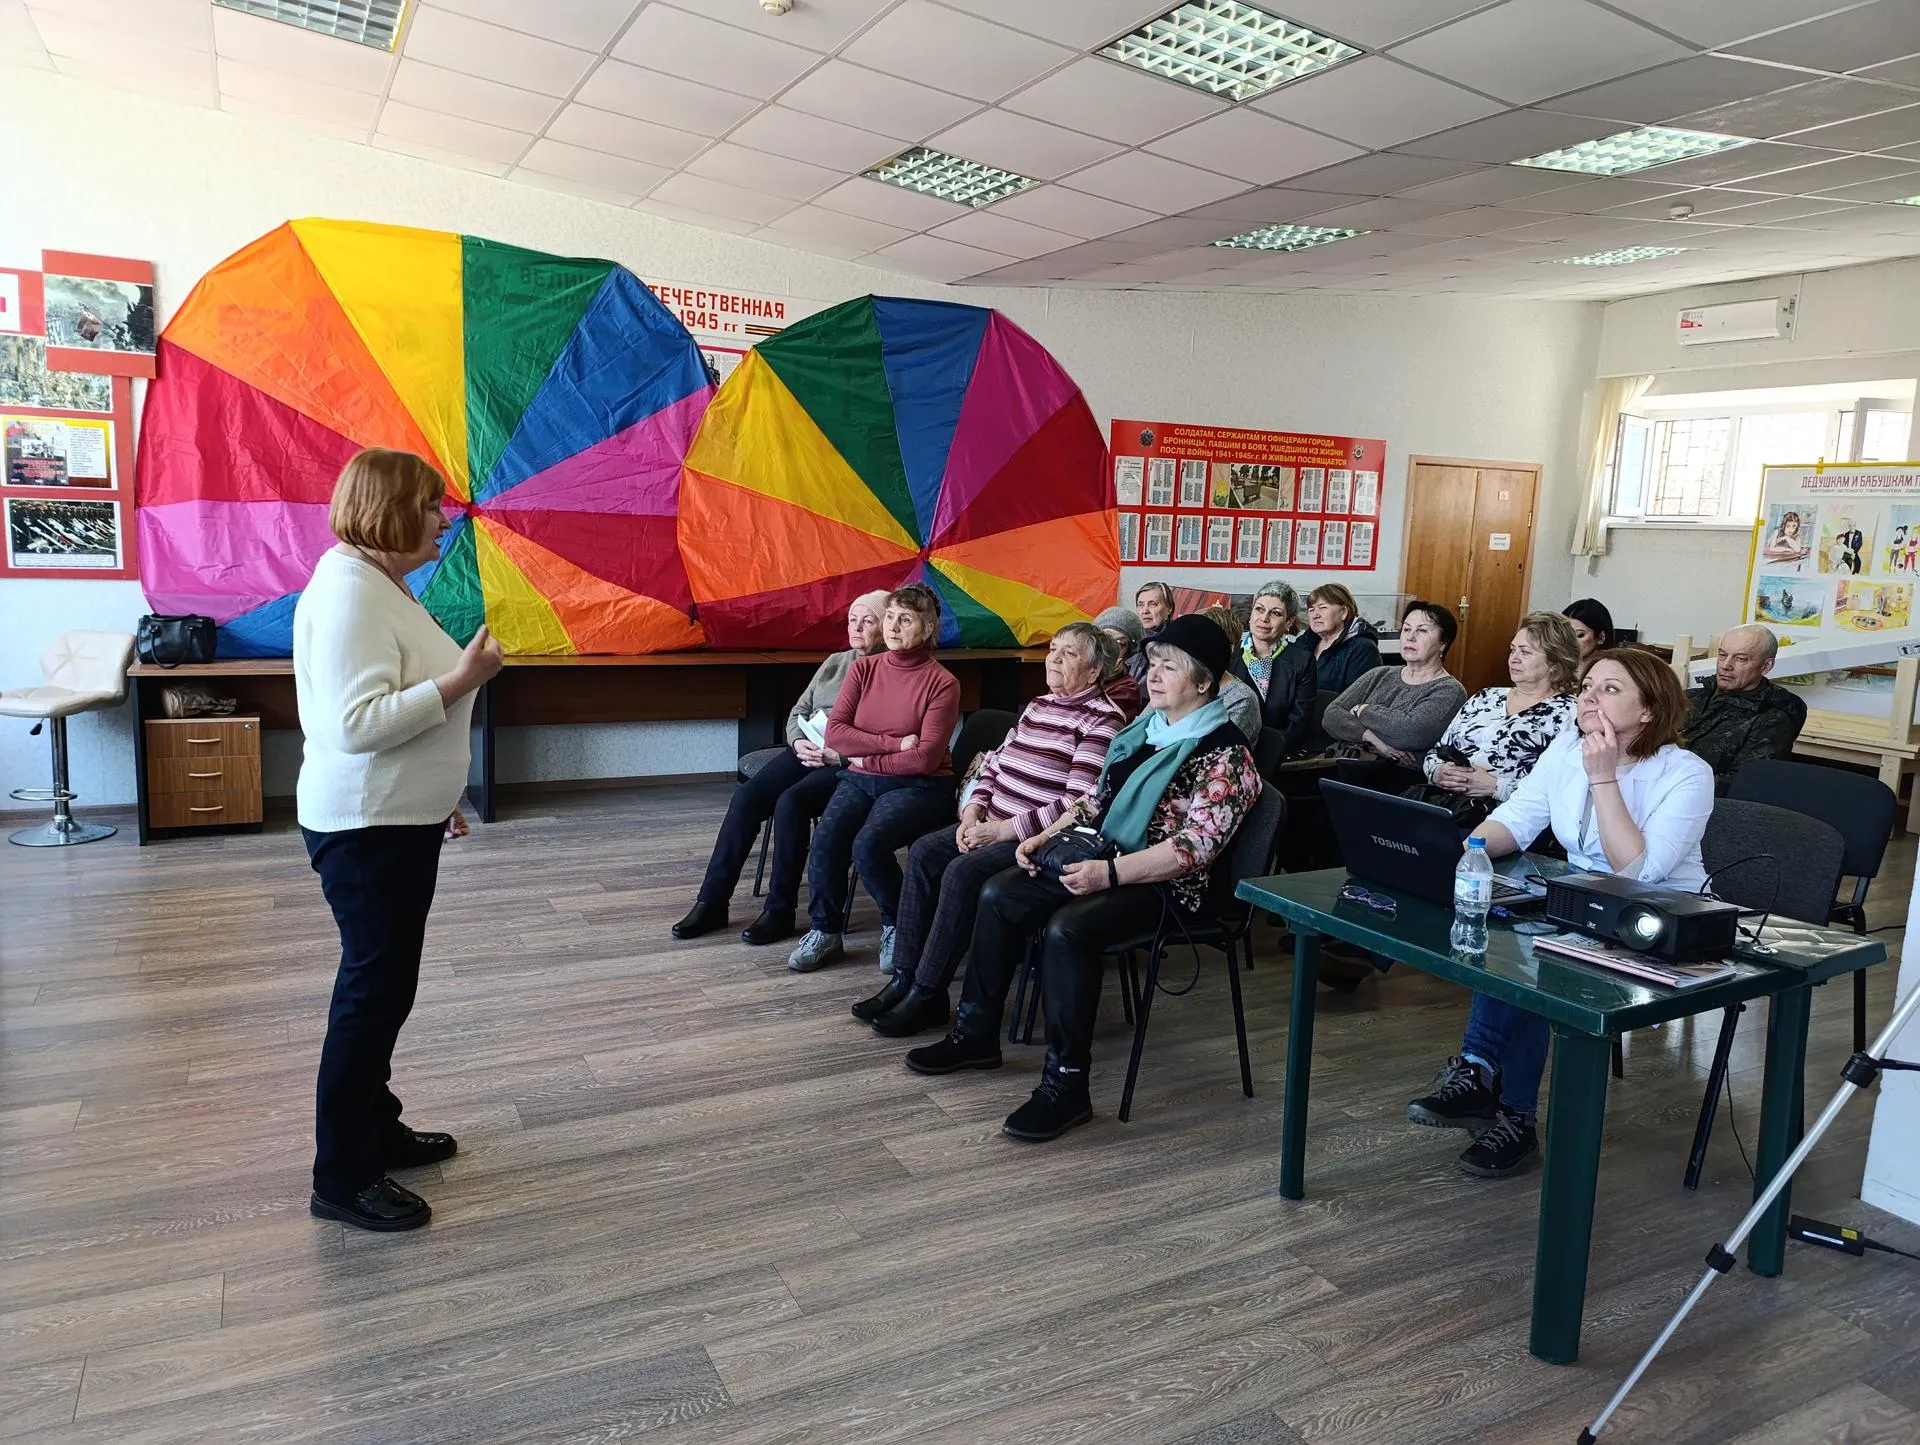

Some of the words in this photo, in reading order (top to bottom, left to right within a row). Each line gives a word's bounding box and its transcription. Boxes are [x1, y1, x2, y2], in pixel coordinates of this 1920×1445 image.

[648, 285, 784, 319] ТЕЧЕСТВЕННАЯ
[1163, 436, 1208, 448] БРОННИЦЫ,
[1208, 440, 1241, 449] ПАВШИМ
[1241, 442, 1247, 450] В
[1247, 443, 1269, 452] БОЯХ,
[1270, 444, 1308, 454] УШЕДШИМ
[1308, 447, 1318, 455] ИЗ
[1319, 448, 1344, 456] ЖИЗНИ
[1174, 428, 1216, 439] СОЛДАТАМ,
[1217, 431, 1260, 441] СЕРЖАНТАМ
[1267, 435, 1307, 444] ОФИЦЕРАМ
[1308, 438, 1335, 447] ГОРОДА
[1160, 446, 1186, 455] ПОСЛЕ
[1187, 448, 1213, 457] ВОЙНЫ
[1268, 454, 1297, 463] ЖИВЫМ
[1298, 455, 1348, 466] ПОСВЯЩАЕТСЯ
[1801, 476, 1850, 488] ДЕДУШКАМ
[1851, 476, 1858, 487] И
[1860, 475, 1912, 487] БАБУШКАМ
[1370, 834, 1419, 856] TOSHIBA
